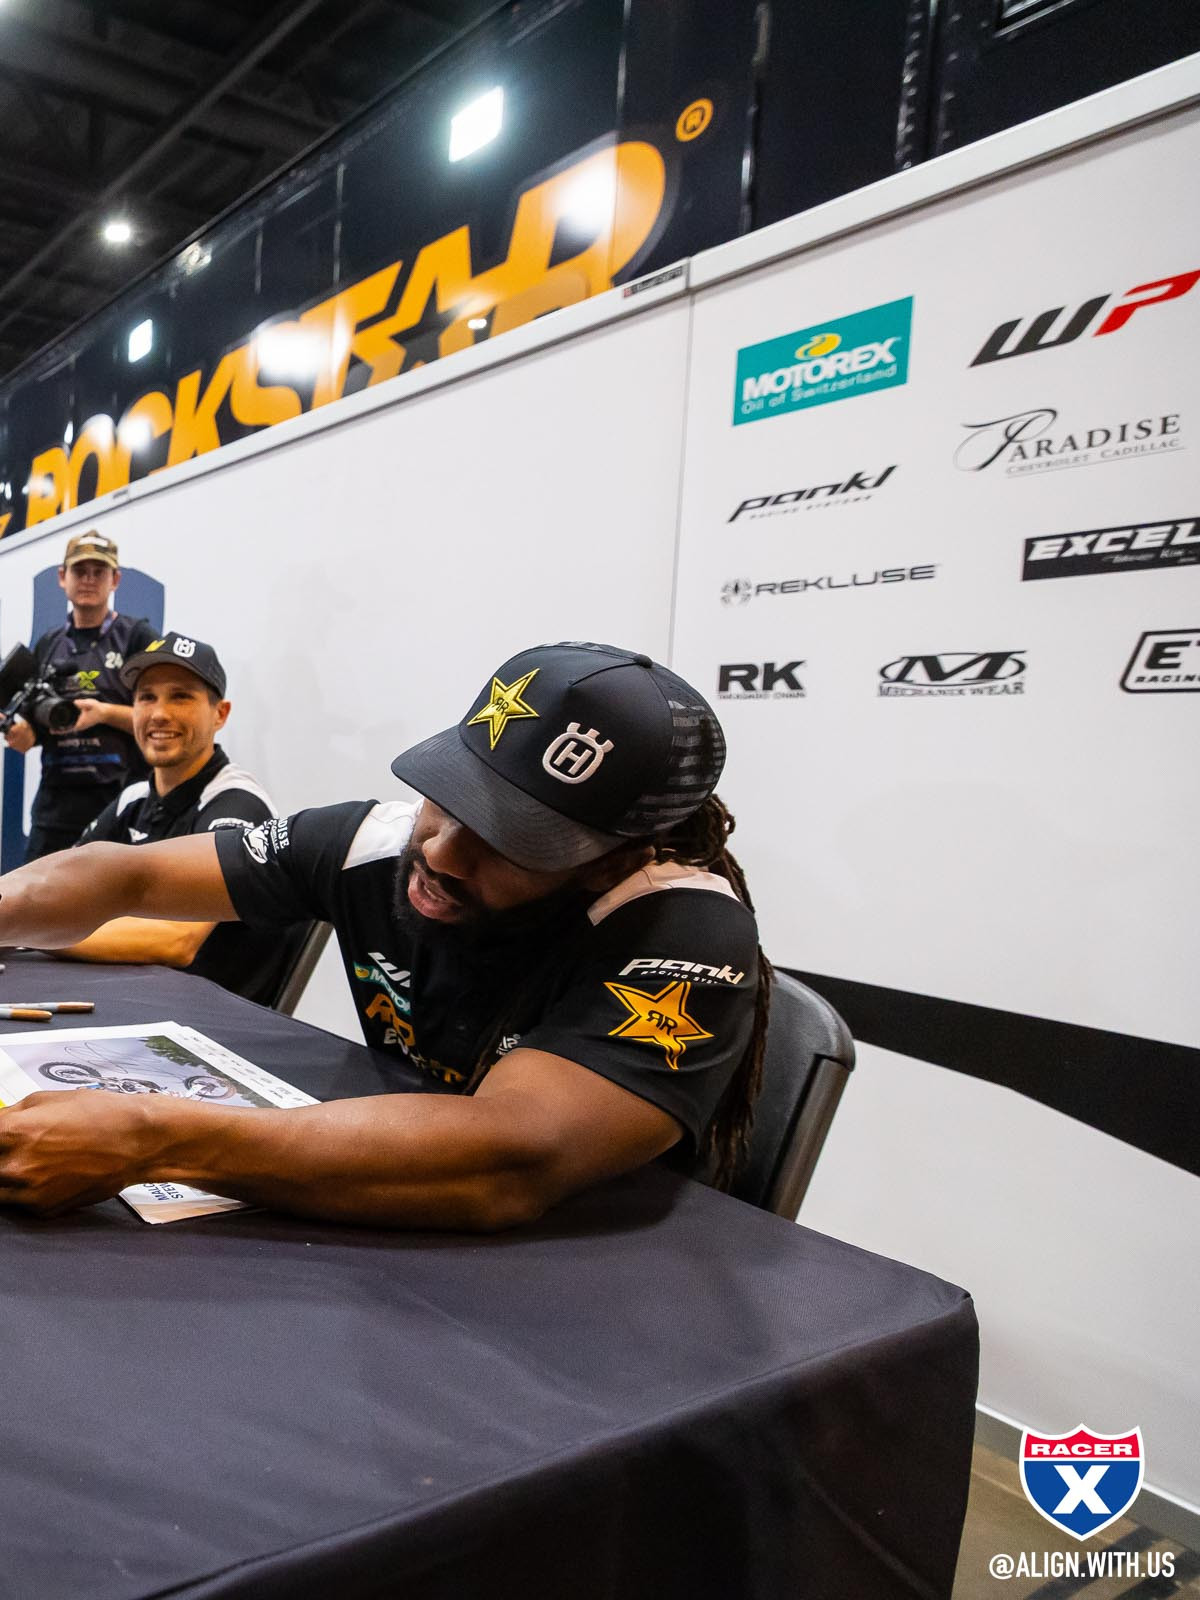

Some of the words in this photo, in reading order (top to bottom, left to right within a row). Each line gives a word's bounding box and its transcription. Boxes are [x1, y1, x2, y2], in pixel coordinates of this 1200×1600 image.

[968, 269, 1200, 368] WP
[741, 399, 765, 415] Oil
[768, 393, 786, 407] of
[791, 364, 898, 401] Switzerland
[742, 337, 900, 401] MOTOREX
[953, 408, 1182, 471] PARADISE
[1027, 521, 1200, 562] EXCEL
[755, 564, 936, 596] REKLUSE
[718, 660, 808, 691] RK
[1135, 674, 1200, 684] RACIN
